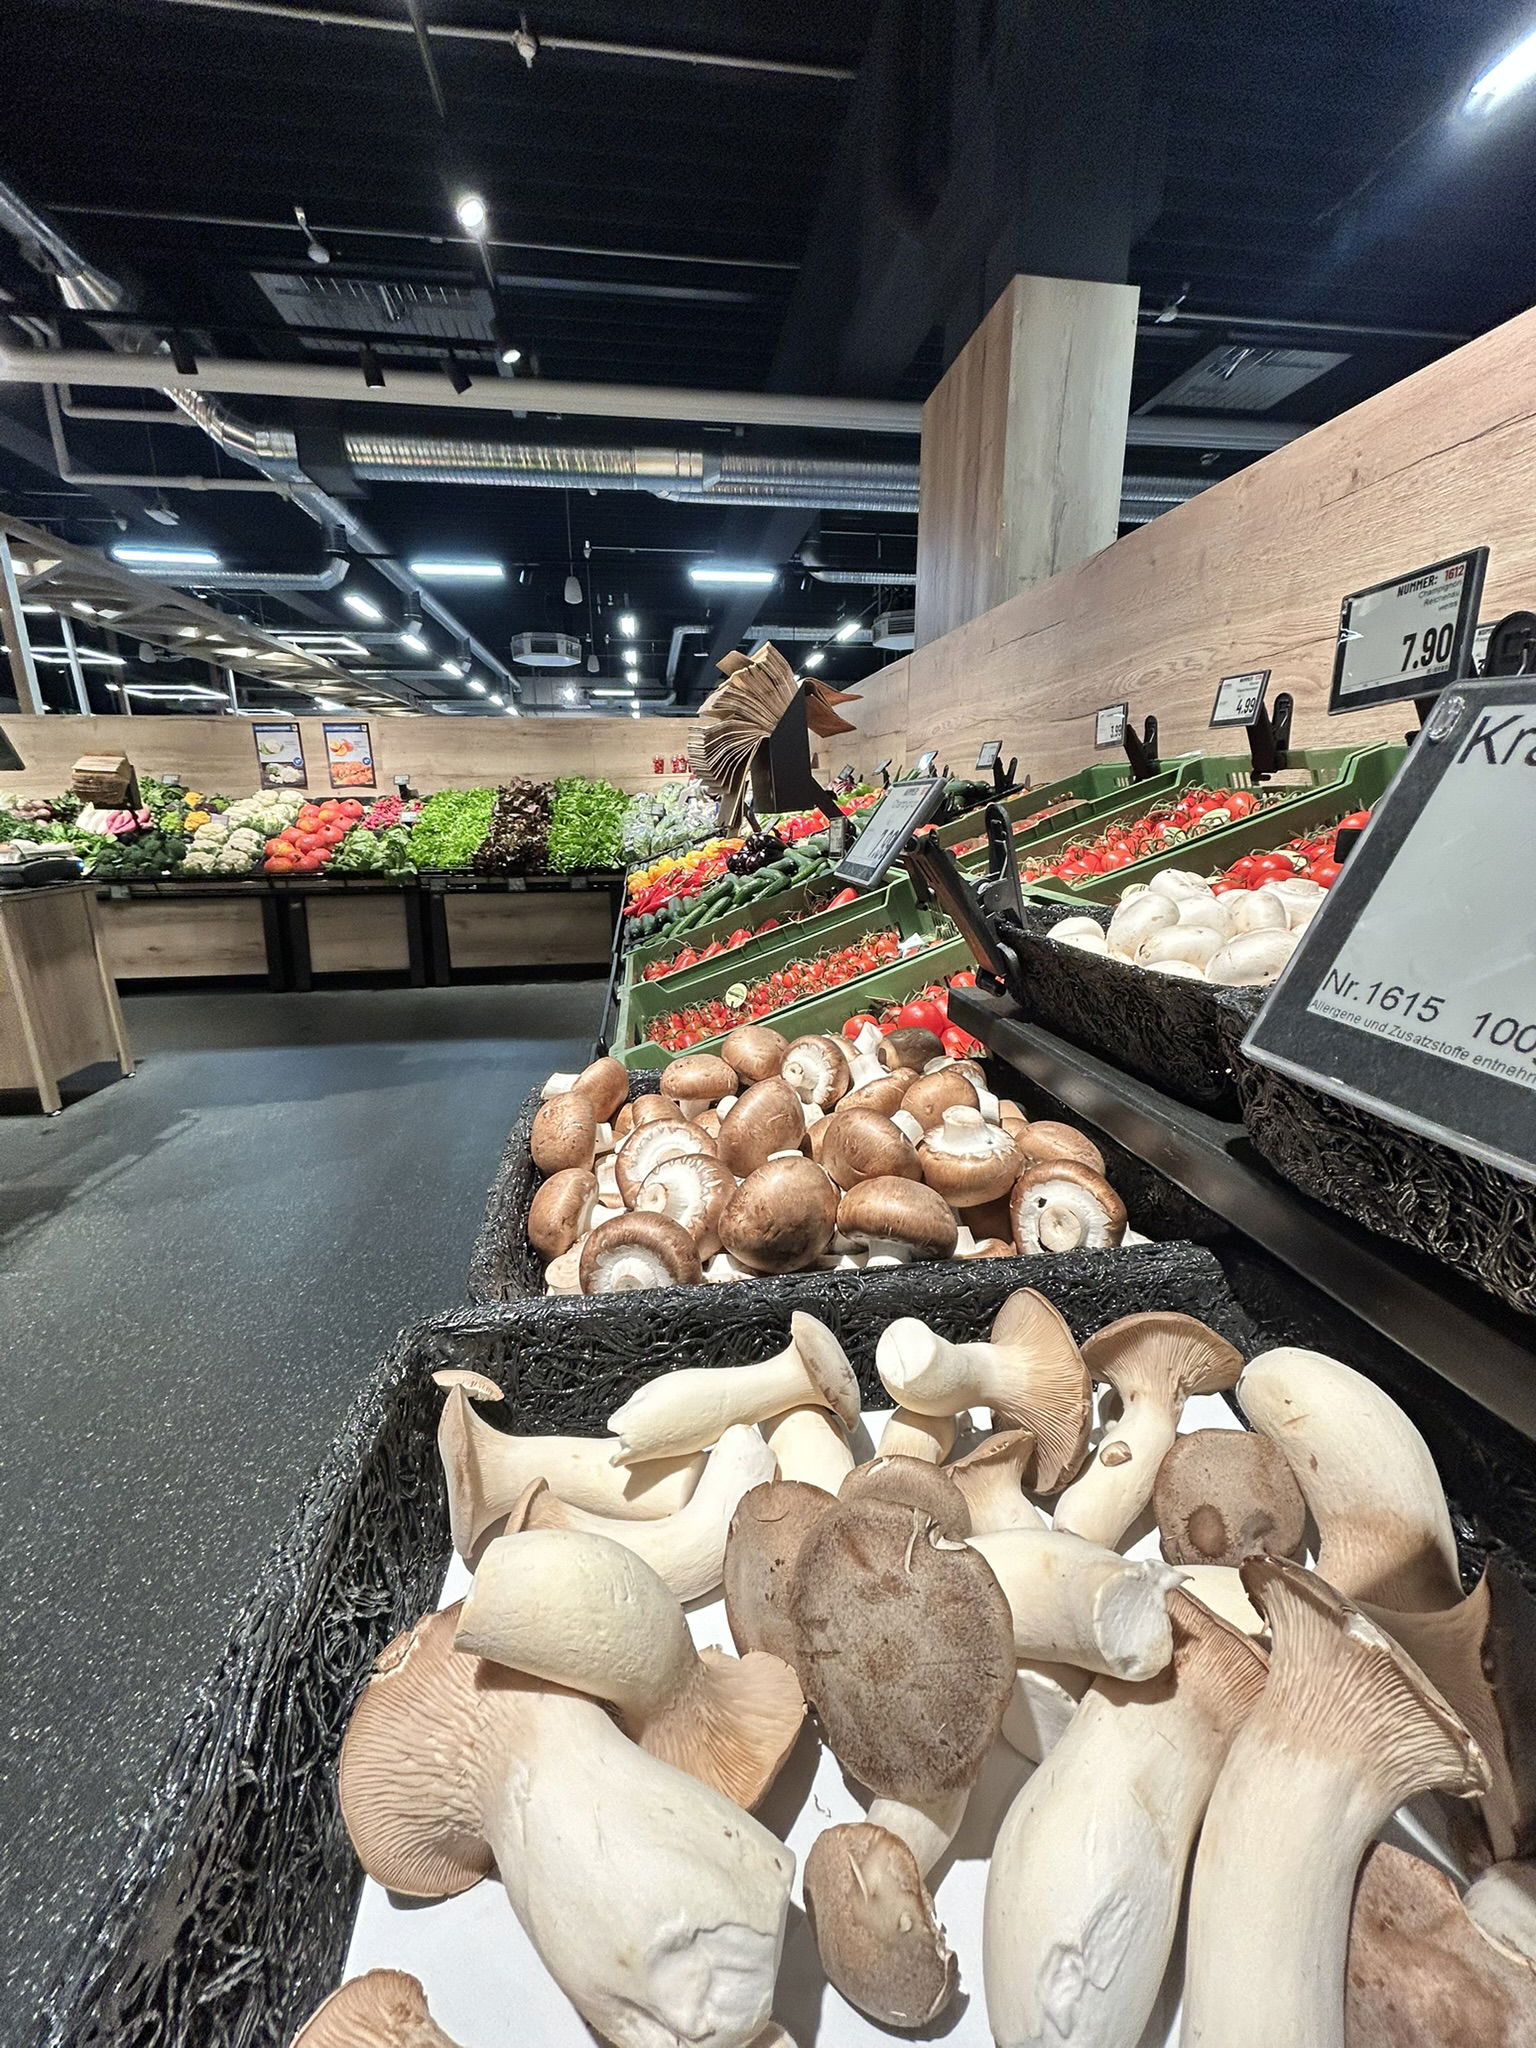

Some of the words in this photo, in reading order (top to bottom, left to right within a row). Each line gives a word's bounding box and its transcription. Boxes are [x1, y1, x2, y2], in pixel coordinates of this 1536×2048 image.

[1397, 575, 1438, 597] NUMMER:
[1445, 565, 1464, 581] 1612
[1401, 623, 1454, 672] 7.90
[1236, 697, 1256, 714] 4.99
[1311, 1000, 1362, 1024] Allergene
[1364, 1019, 1389, 1033] und
[1388, 1024, 1469, 1060] Zusatzstoffe
